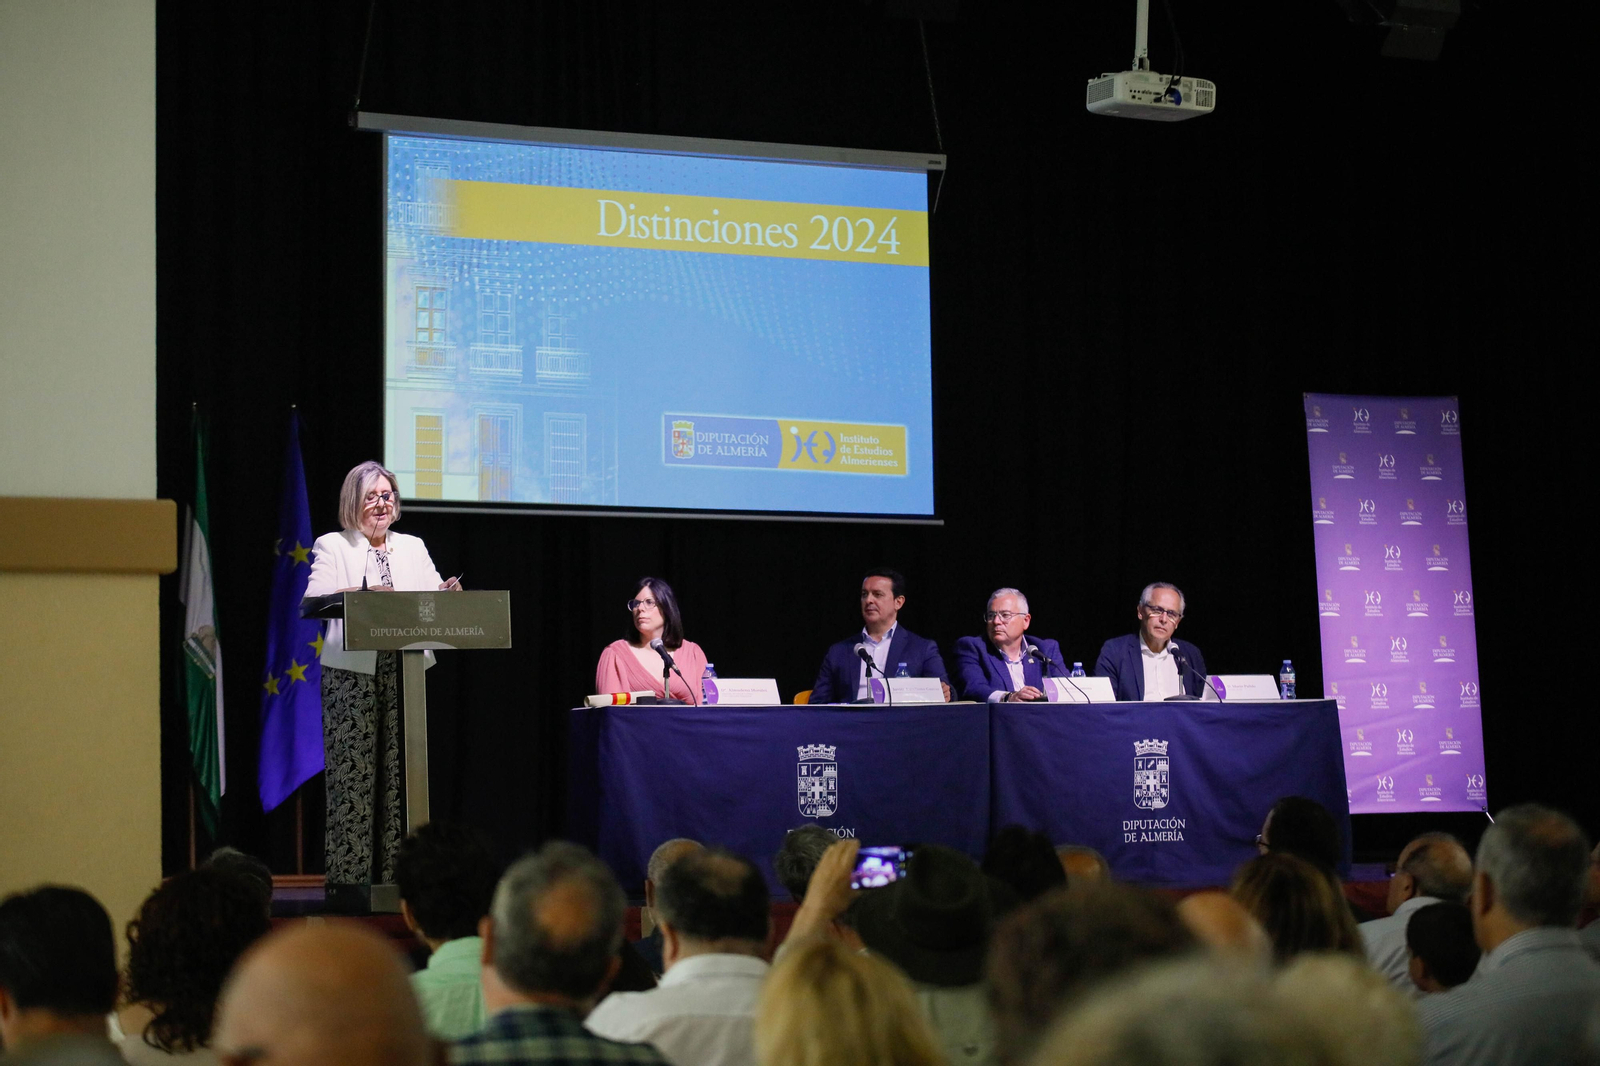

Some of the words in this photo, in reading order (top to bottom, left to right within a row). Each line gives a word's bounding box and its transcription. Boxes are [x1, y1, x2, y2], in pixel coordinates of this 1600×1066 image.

[597, 199, 798, 248] Distinciones
[810, 214, 900, 254] 2024
[696, 432, 769, 445] DIPUTACIÓN
[840, 433, 880, 445] Instituto
[698, 444, 714, 455] DE
[715, 444, 768, 457] ALMERÍA
[840, 445, 852, 454] de
[853, 446, 893, 456] Estudios
[840, 456, 898, 468] Almerienses
[370, 626, 428, 637] DIPUTACIÓN
[430, 628, 442, 636] DE
[444, 626, 484, 636] ALMERÍA
[1123, 817, 1186, 830] DIPUTACIÓN
[1124, 833, 1137, 843] DE
[1140, 829, 1184, 842] ALMERÍA
